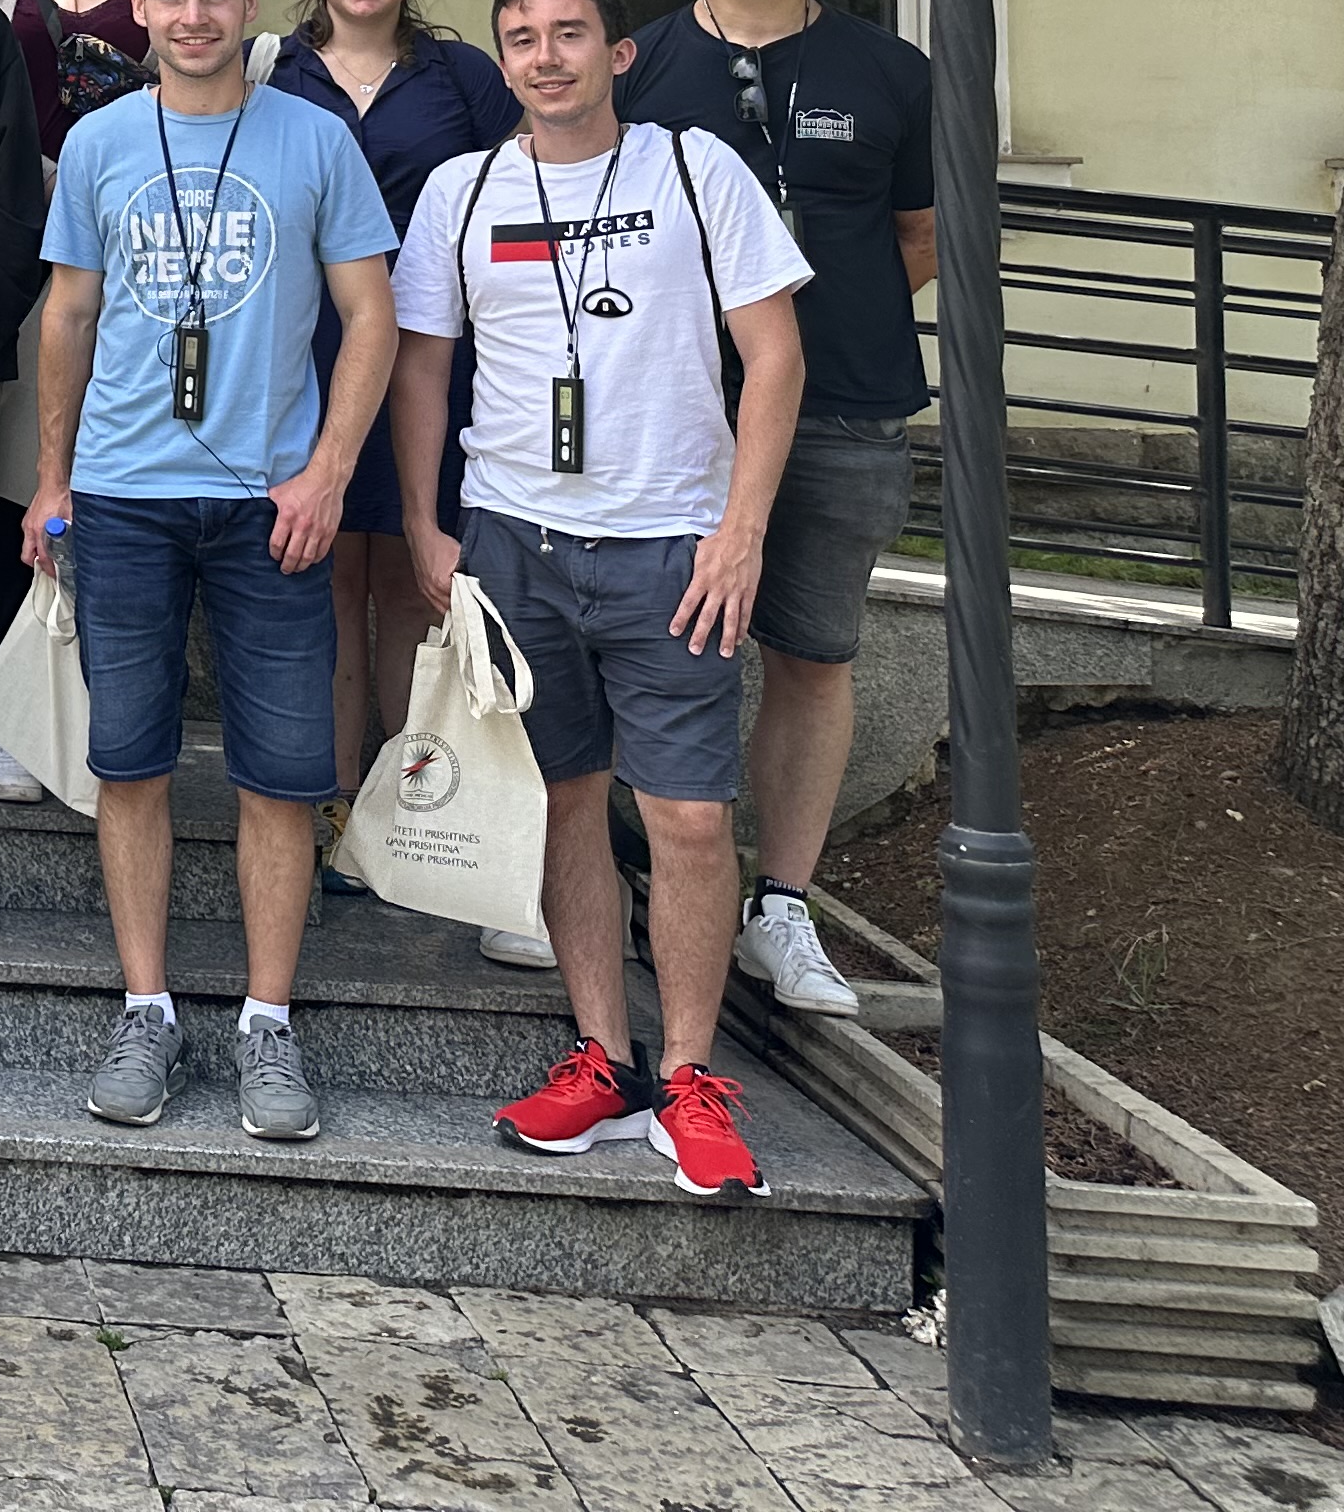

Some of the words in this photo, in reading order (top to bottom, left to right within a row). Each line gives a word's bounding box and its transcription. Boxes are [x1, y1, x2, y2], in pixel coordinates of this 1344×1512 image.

[175, 189, 215, 207] CORE
[129, 210, 257, 250] NINE
[565, 232, 651, 256] JONES
[131, 250, 253, 285] ZERO
